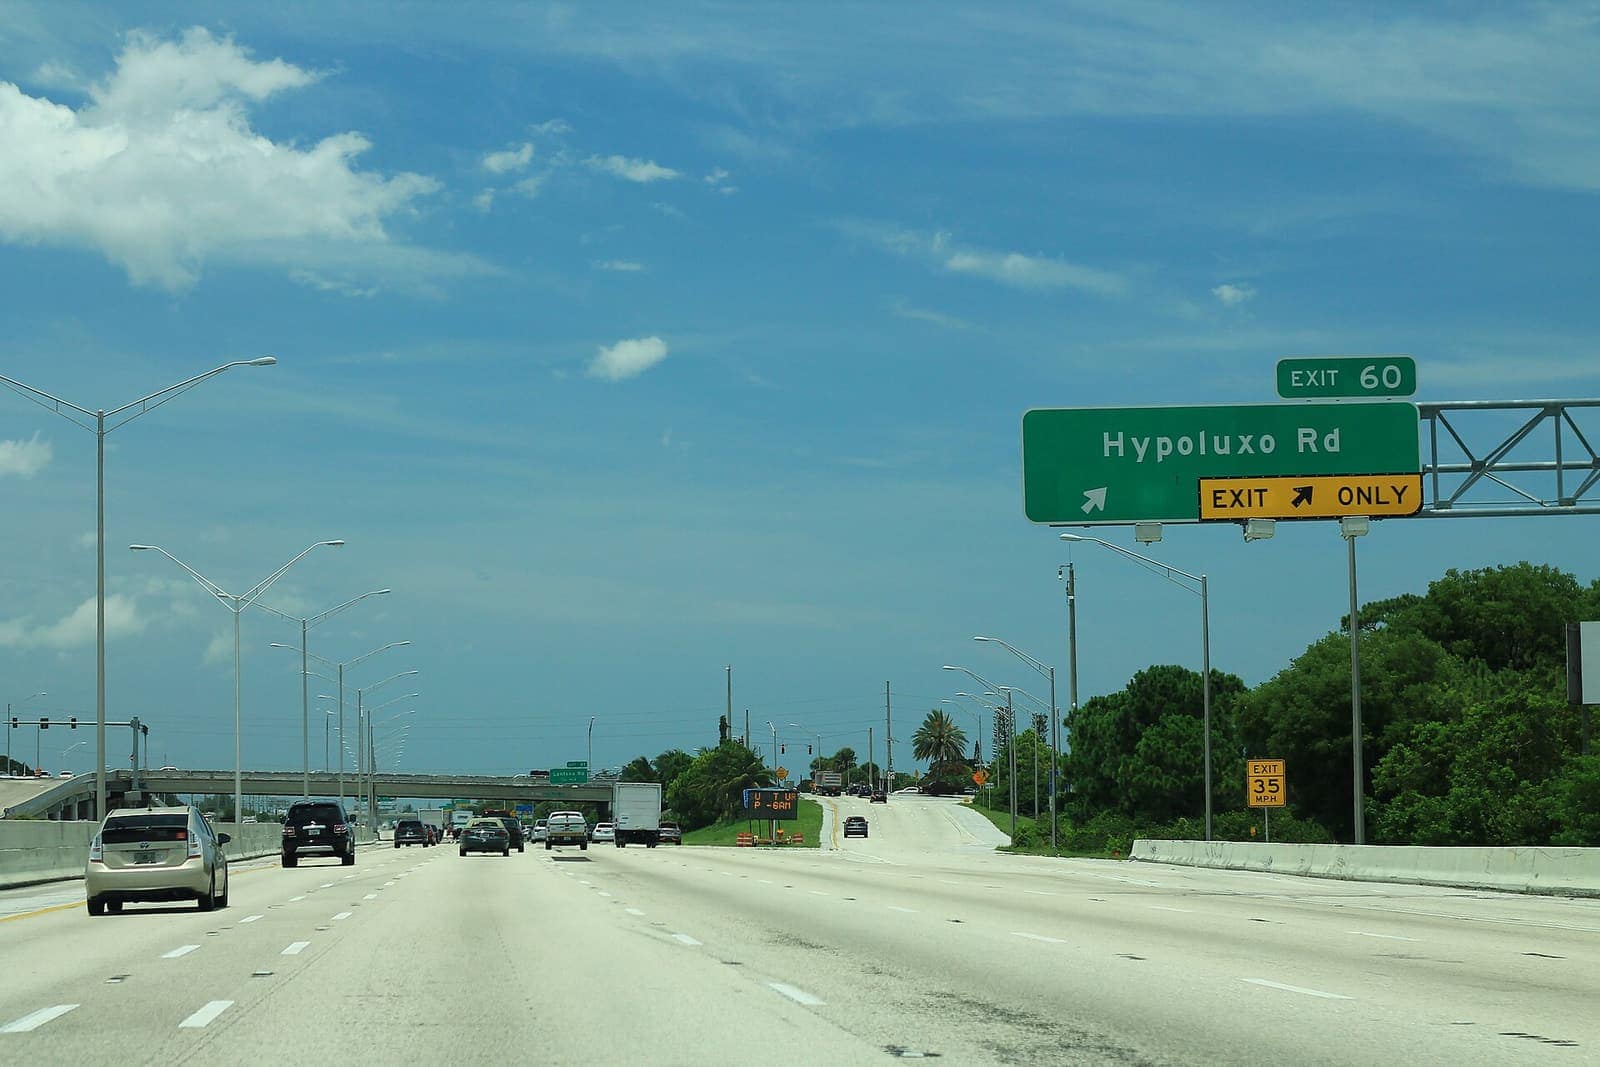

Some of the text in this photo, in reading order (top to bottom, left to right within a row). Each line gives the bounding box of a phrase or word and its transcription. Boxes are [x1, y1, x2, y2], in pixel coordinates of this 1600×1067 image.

[1291, 365, 1402, 389] EXIT 60
[1103, 427, 1341, 462] Hypoluxo Rd
[1213, 485, 1409, 508] EXIT ONLY
[1253, 765, 1278, 774] EXIT
[1253, 779, 1279, 793] 35
